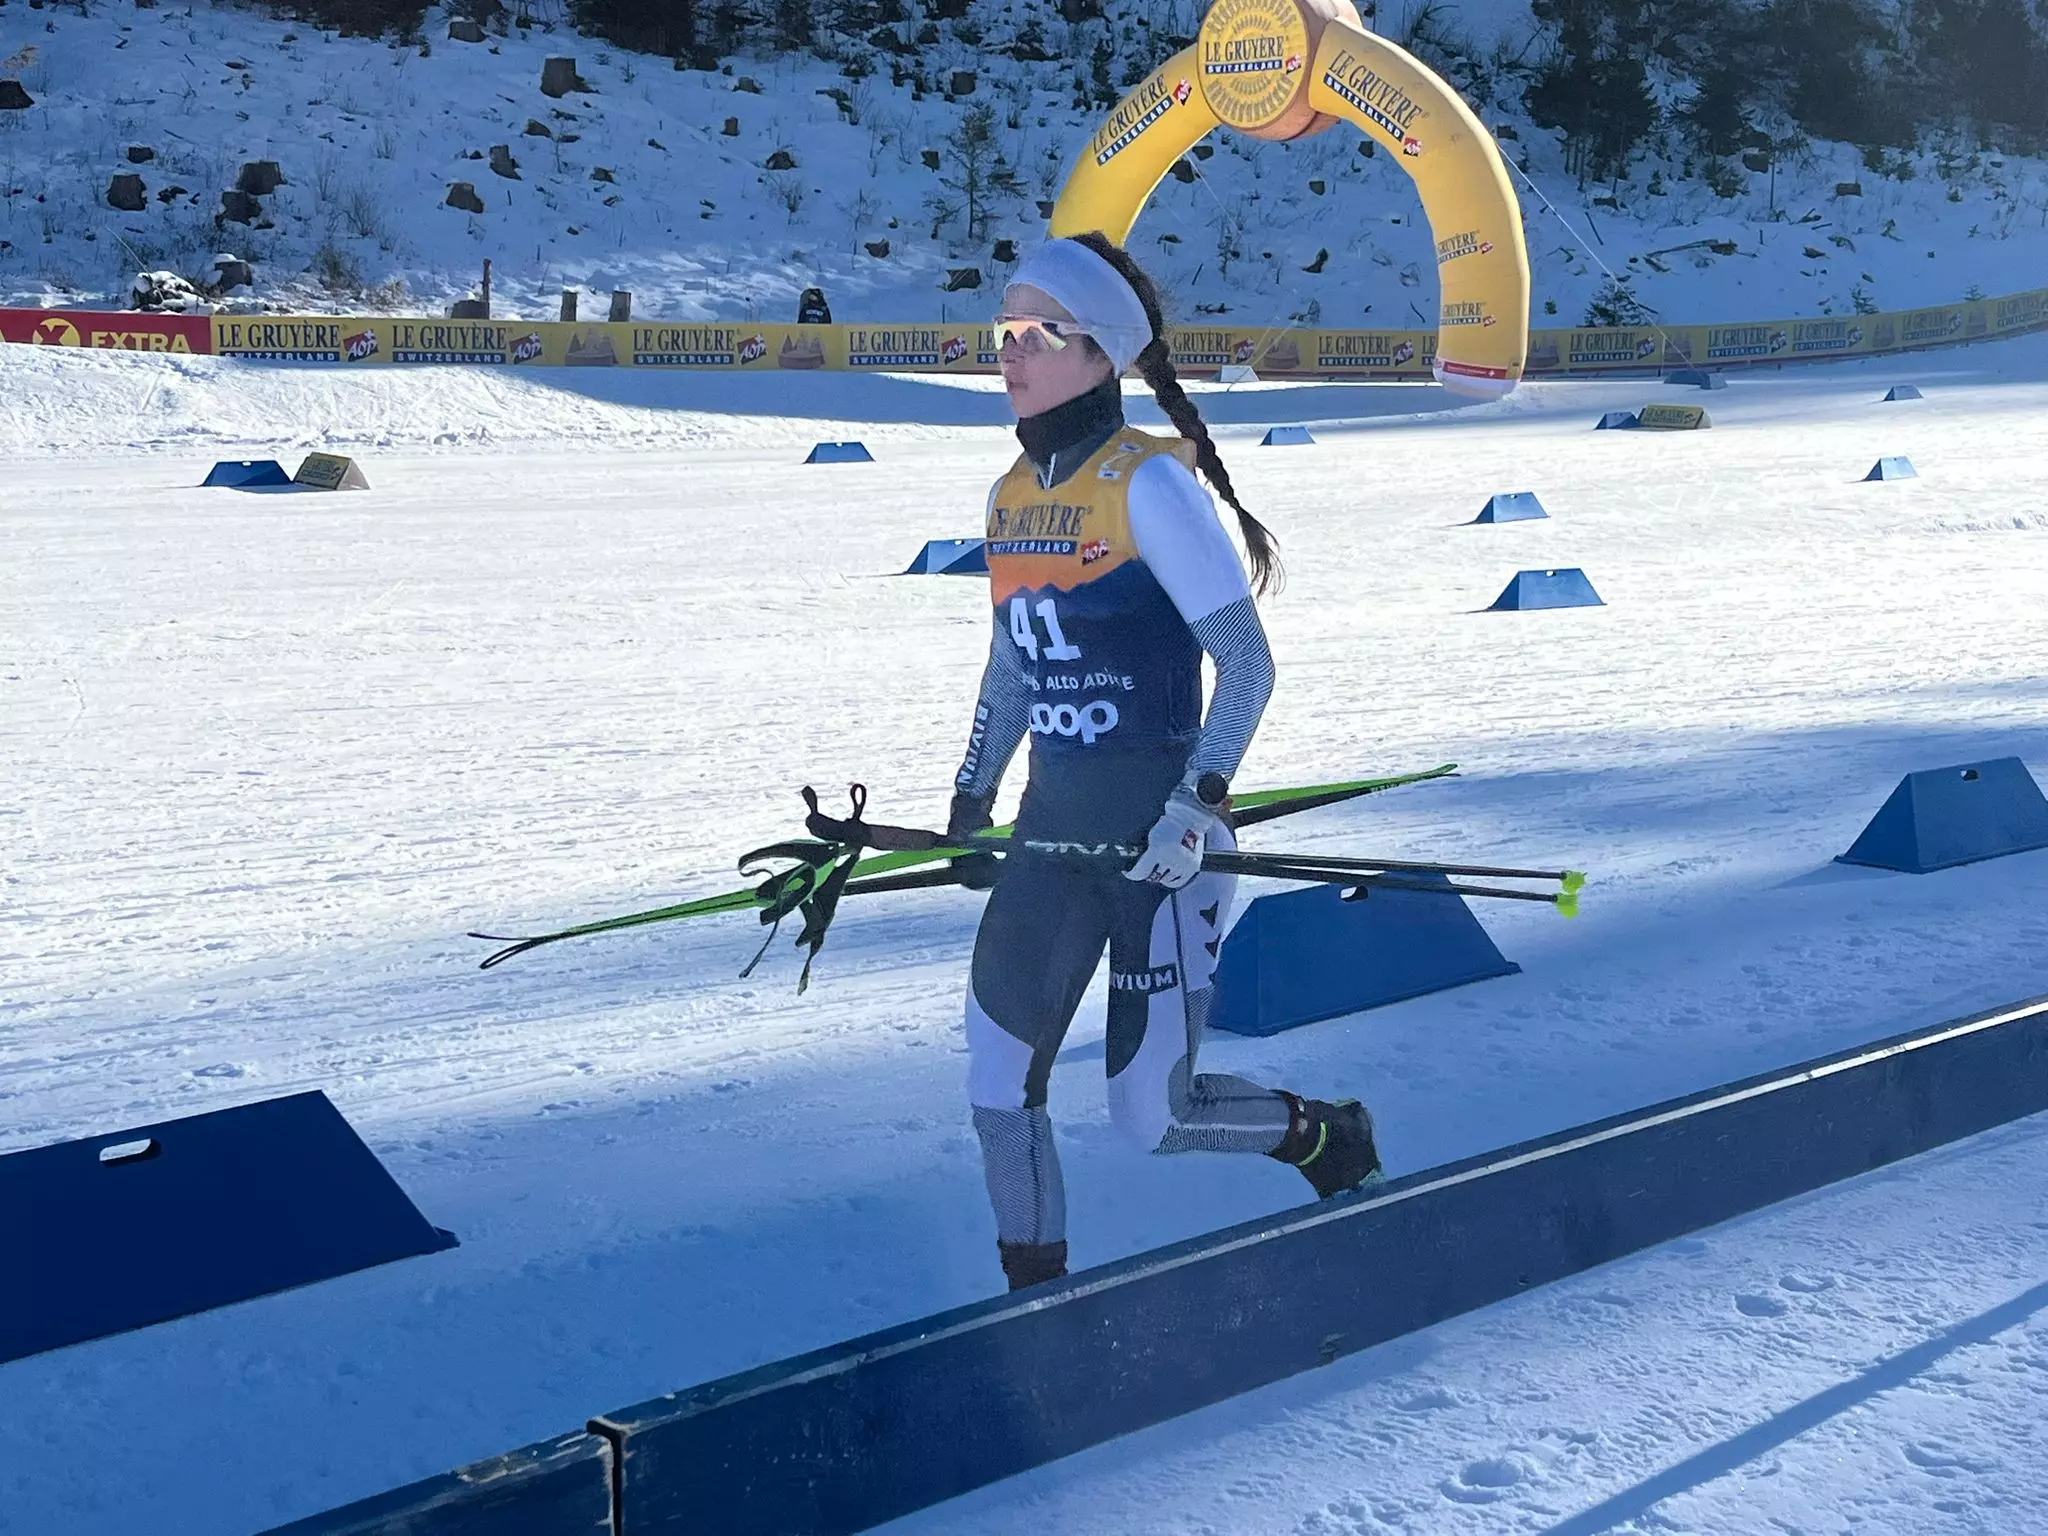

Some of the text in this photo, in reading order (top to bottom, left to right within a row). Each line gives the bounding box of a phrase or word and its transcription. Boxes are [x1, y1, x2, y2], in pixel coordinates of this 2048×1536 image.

[1206, 34, 1285, 62] LE GRUYÈRE
[1329, 49, 1356, 79] LE
[1348, 64, 1423, 129] GRUYÈRE
[1325, 76, 1401, 139] SWITZERLAND
[1092, 127, 1108, 155] LE
[1098, 98, 1172, 165] SWITZERLAND
[91, 331, 192, 354] EXTRA
[218, 319, 341, 349] LE GRUYÈRE
[392, 321, 507, 350] LE GRUYÈRE
[633, 324, 736, 352] LE GRUYÈRE
[849, 326, 940, 353] LE GRUYÈRE
[976, 330, 996, 352] LE
[1319, 332, 1392, 355] LE GRUYÈRE
[1422, 335, 1437, 354] LE
[224, 351, 336, 362] SWITZERLAND
[397, 352, 502, 363] SWITZERLAND
[637, 355, 731, 364] SWITZERLAND
[852, 355, 936, 366] SWITZERLAND
[1010, 597, 1082, 662] 41
